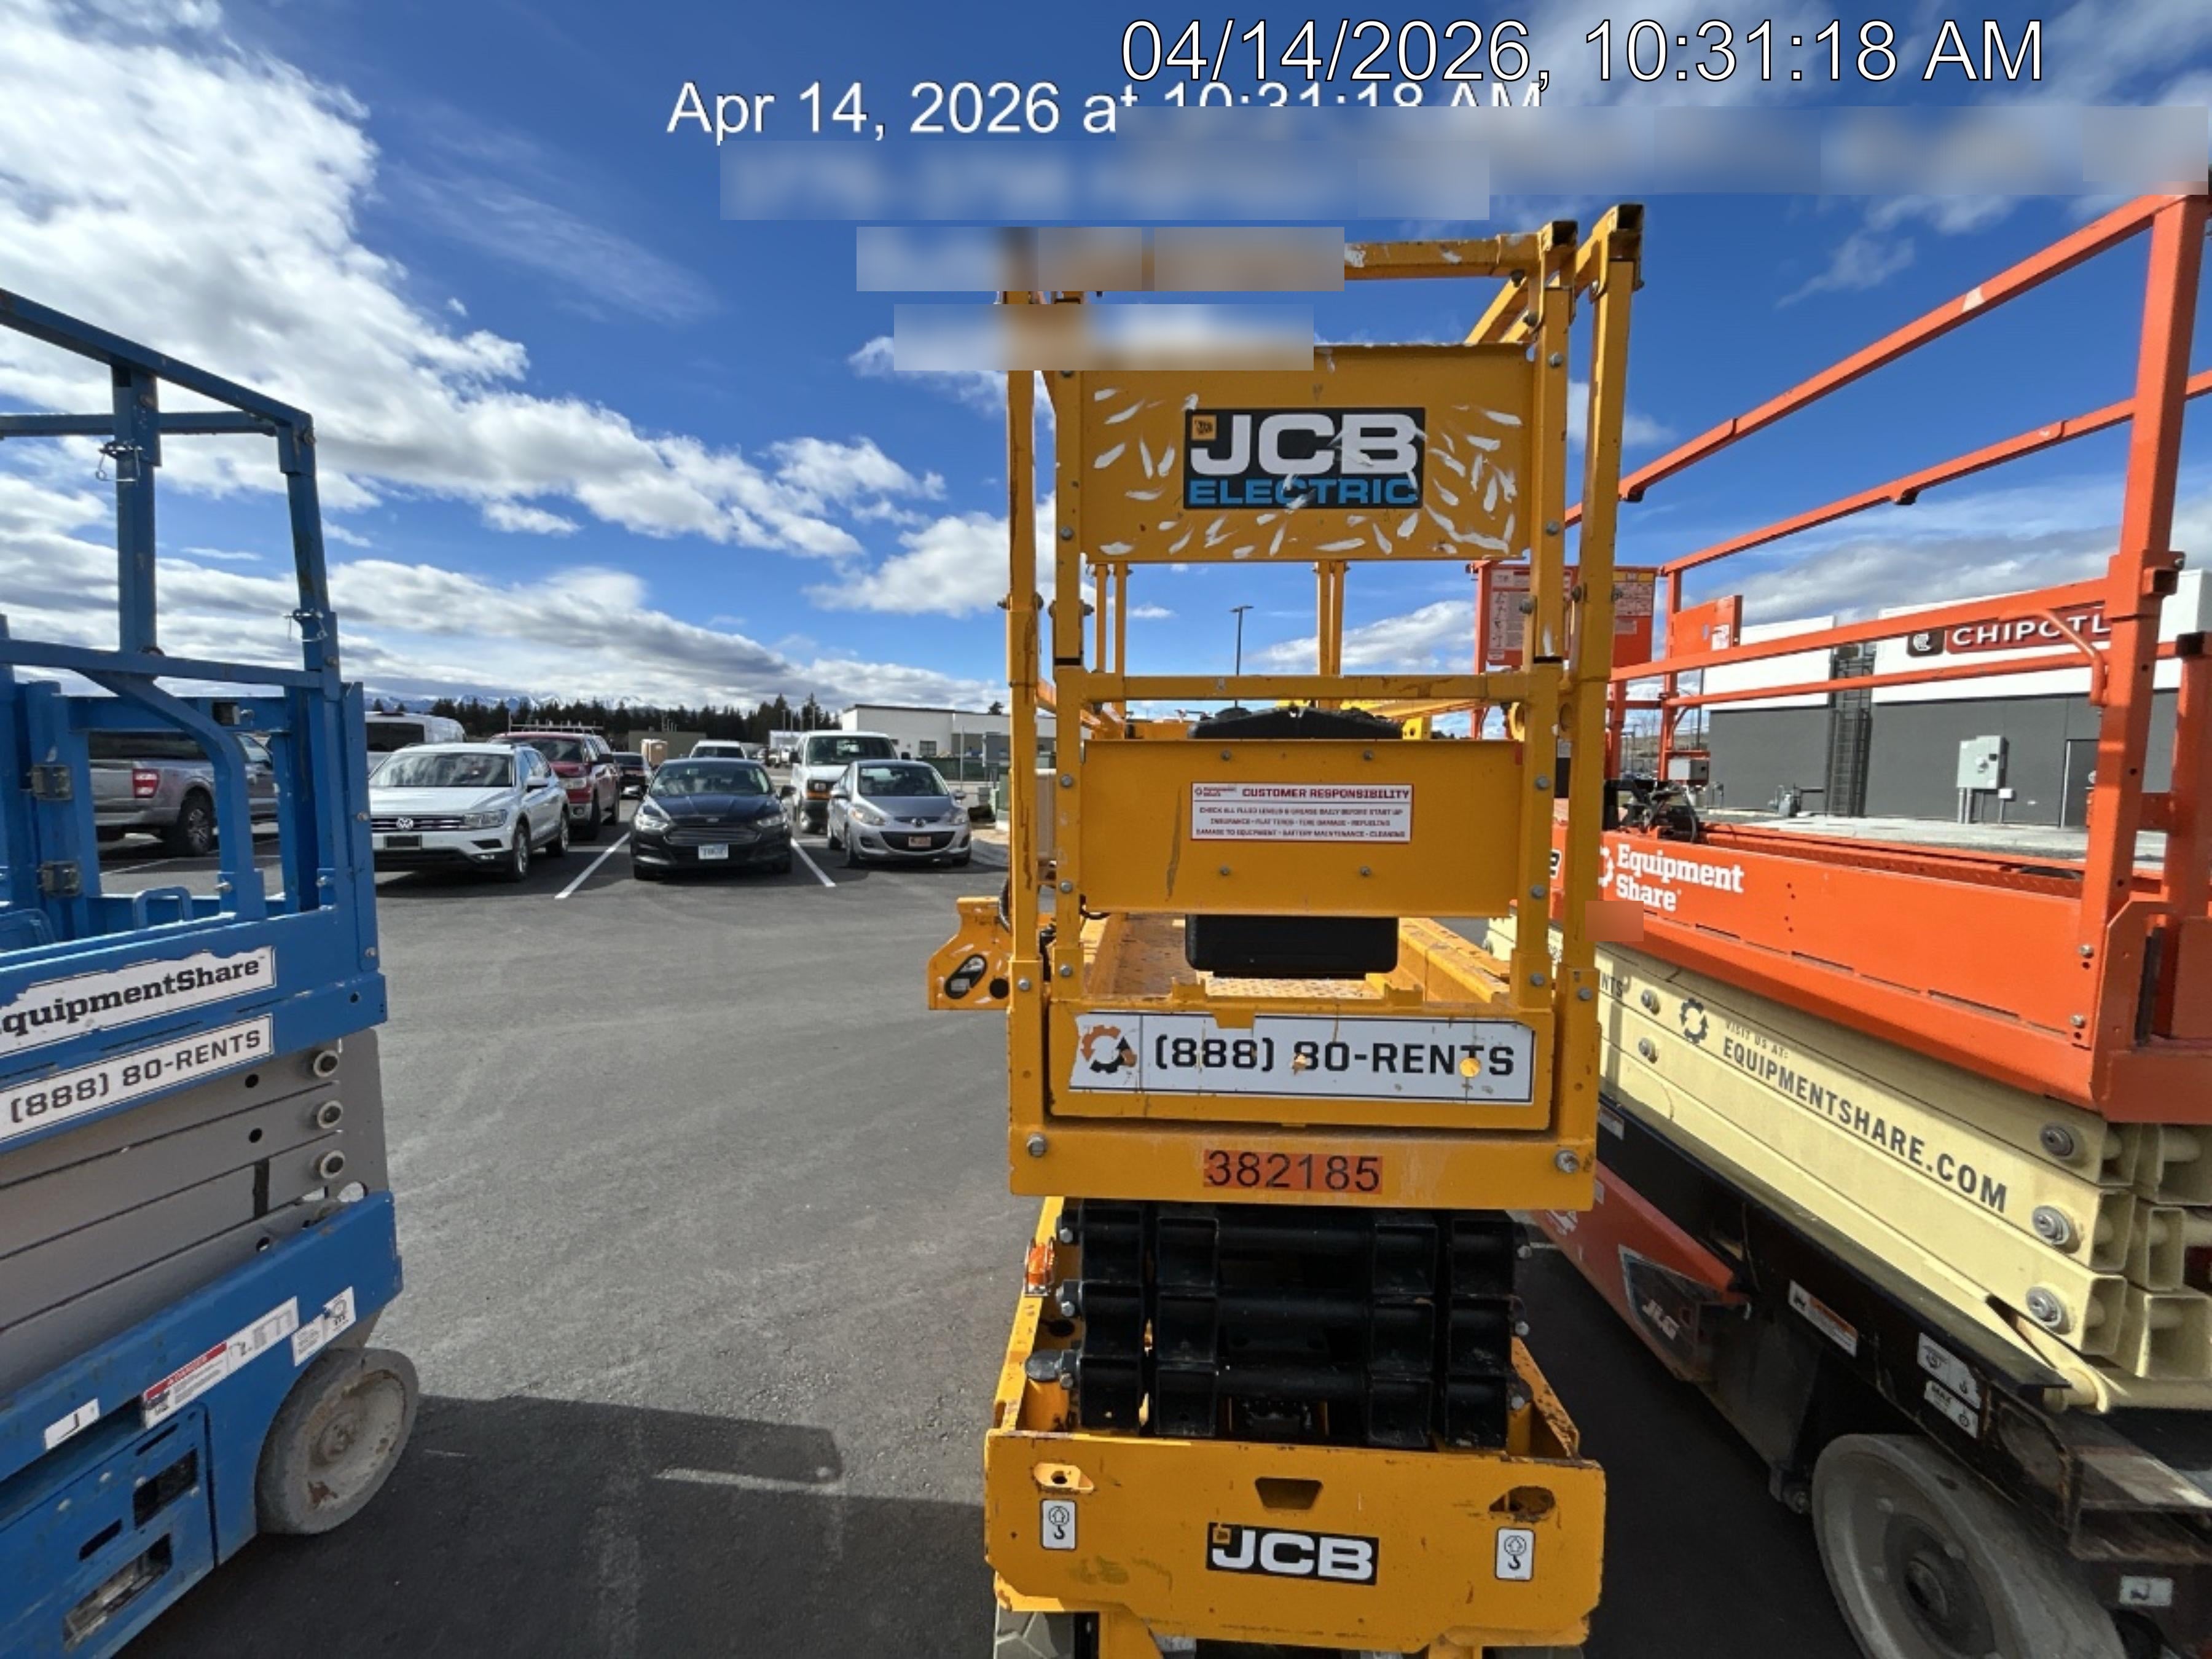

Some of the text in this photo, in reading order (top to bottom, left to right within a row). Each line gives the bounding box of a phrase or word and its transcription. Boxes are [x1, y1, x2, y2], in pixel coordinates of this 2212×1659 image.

[1190, 414, 1418, 476] JCB
[1189, 479, 1418, 504] ELECTRIC
[1952, 613, 2111, 646] CHIPOTL
[1242, 788, 1307, 798] CUSTOMER
[1310, 789, 1409, 799] RESPONSIBILITY
[1617, 843, 1744, 893] Equipment
[1616, 873, 1677, 912] Share
[0, 959, 259, 1037] quipmentShare
[11, 1029, 261, 1123] (888) 80-RENTS
[1155, 1034, 1514, 1076] (888) 80-RENTS
[1723, 1037, 2007, 1214] EQUIPMENTSHARE.COM
[1208, 1150, 1380, 1192] 382185
[1212, 1529, 1373, 1581] JCB
